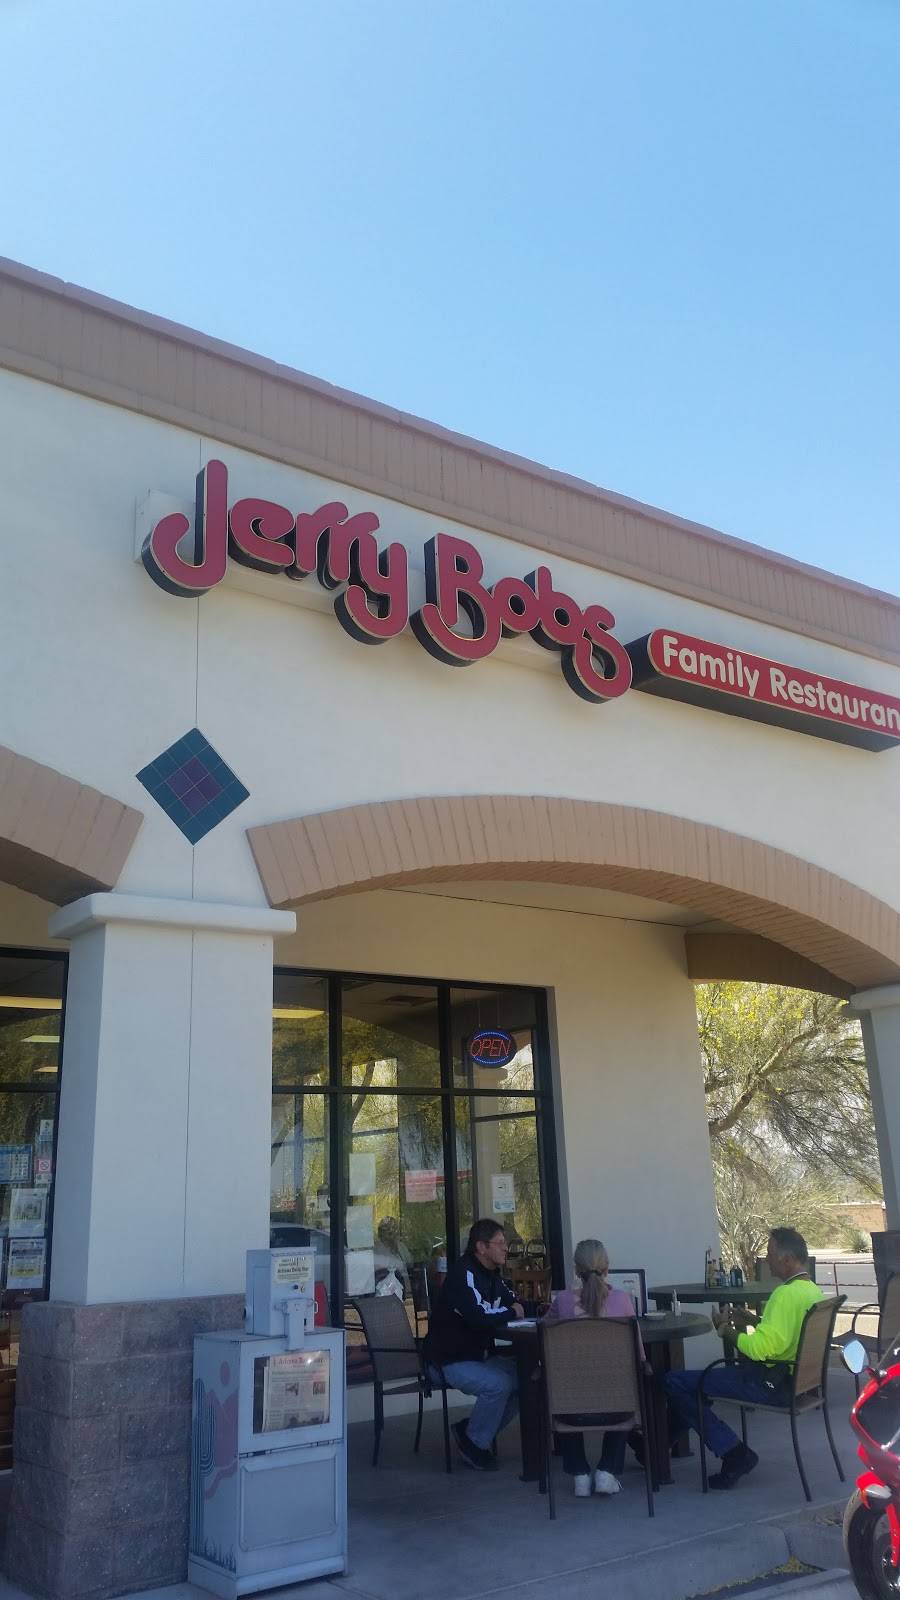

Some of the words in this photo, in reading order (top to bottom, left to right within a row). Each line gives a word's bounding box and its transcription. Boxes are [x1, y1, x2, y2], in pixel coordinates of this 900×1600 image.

[146, 458, 410, 641] Jerry
[417, 532, 634, 700] Bobs
[662, 634, 760, 698] Family
[470, 1038, 512, 1057] OPEN
